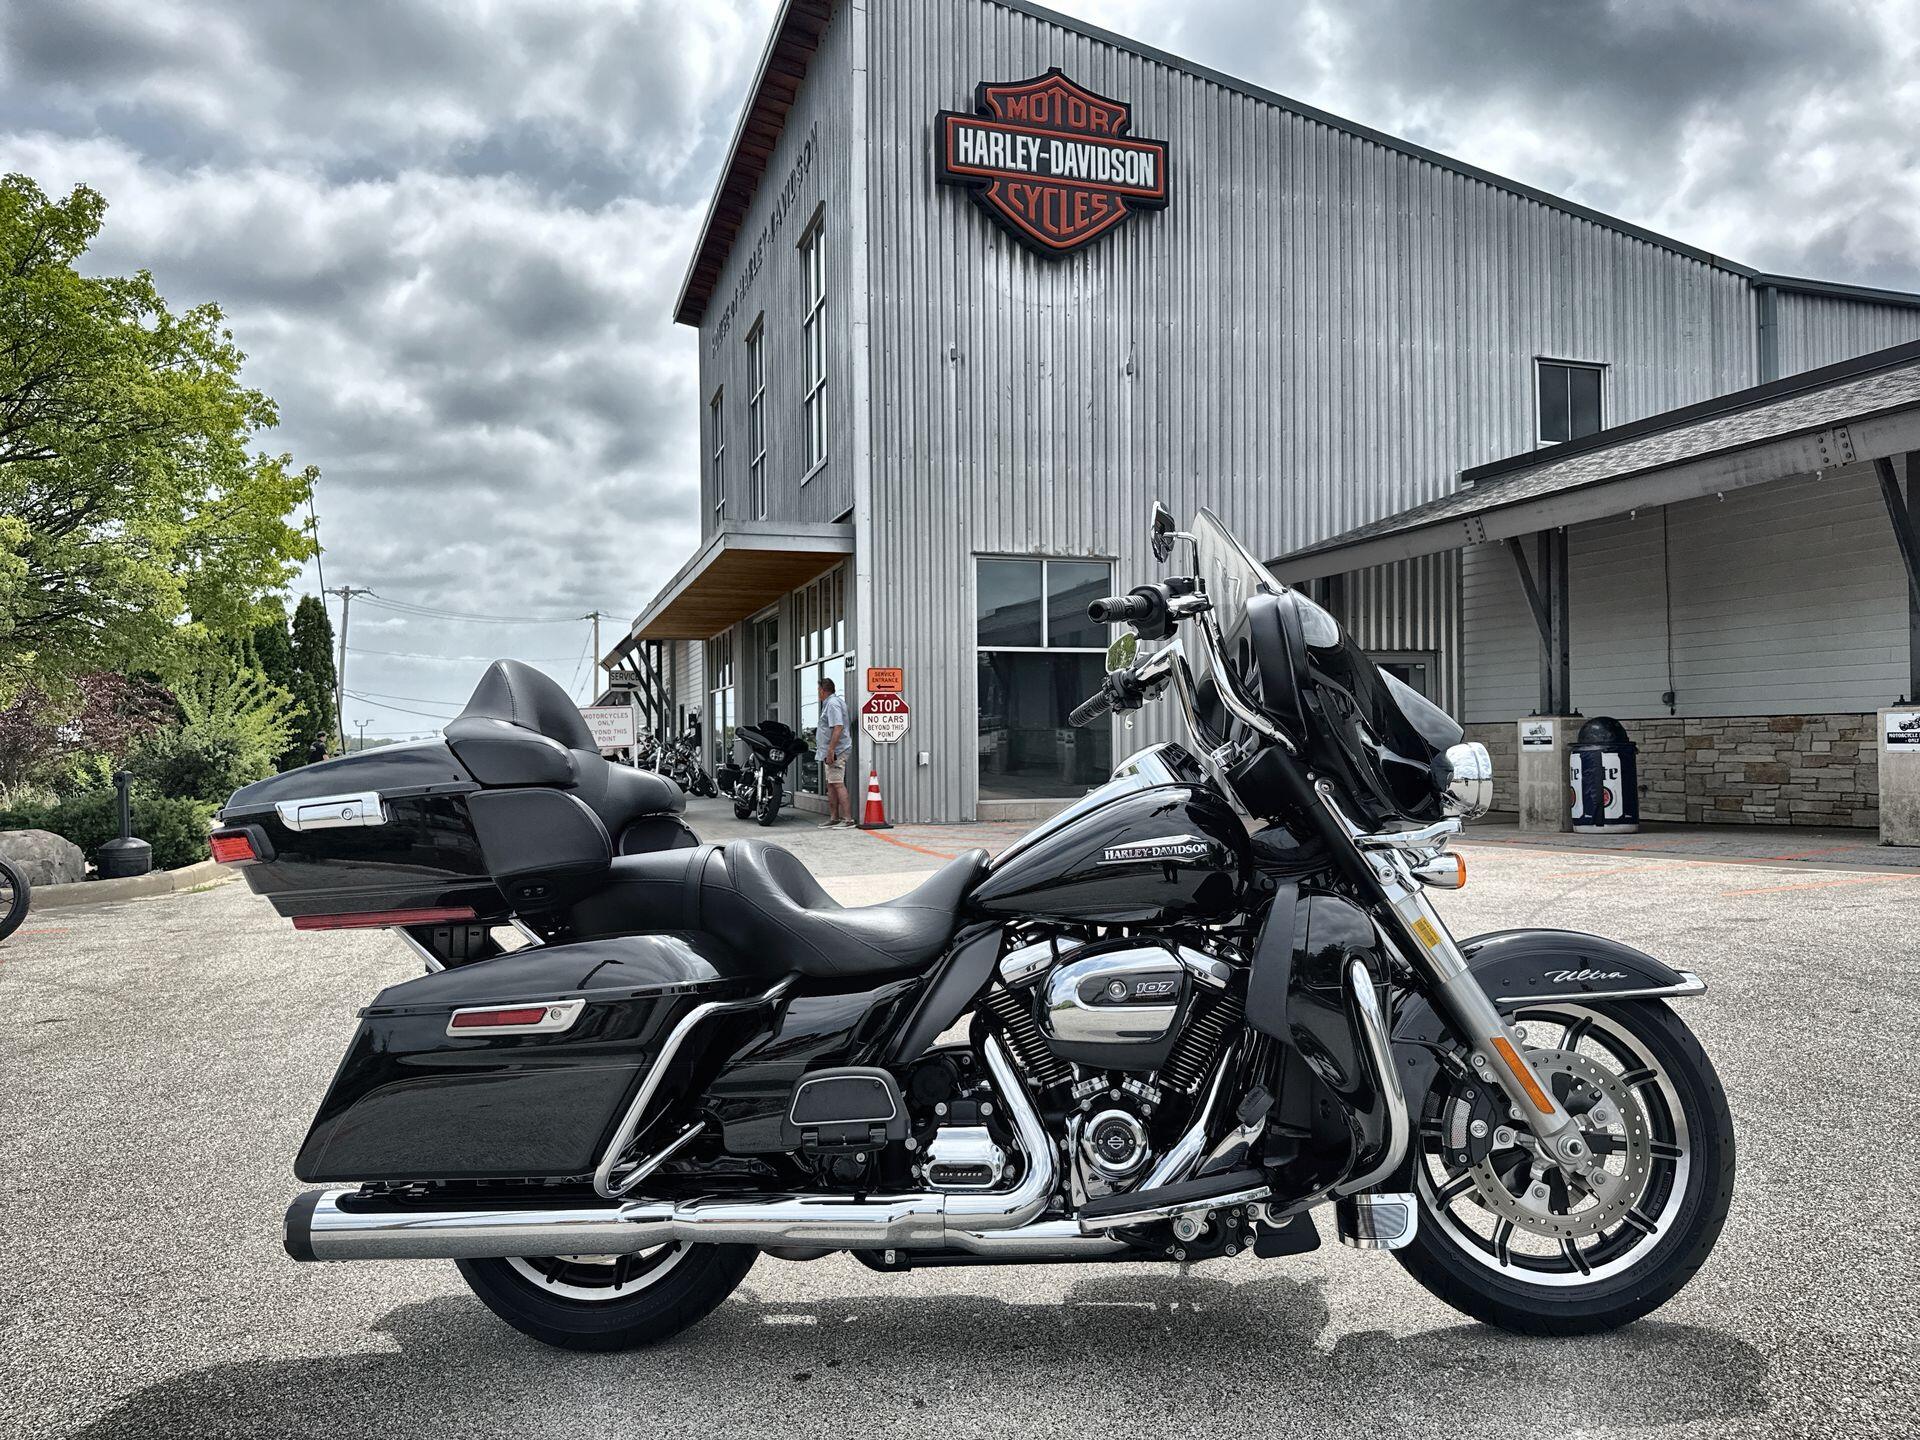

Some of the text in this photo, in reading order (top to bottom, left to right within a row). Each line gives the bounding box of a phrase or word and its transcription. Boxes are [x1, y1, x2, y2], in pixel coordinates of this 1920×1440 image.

[1007, 87, 1109, 133] MOTOR
[958, 127, 1154, 187] HARLEY-DAVIDSON
[1007, 183, 1107, 235] CYCLES
[871, 699, 900, 712] STOP
[583, 712, 629, 720] MOTORCYCLES
[867, 715, 904, 723] NO CARS
[1602, 766, 1618, 780] te
[1104, 843, 1208, 860] HARLEY-DAVIDSON
[1544, 968, 1628, 983] Ultra
[1136, 981, 1175, 994] 107
